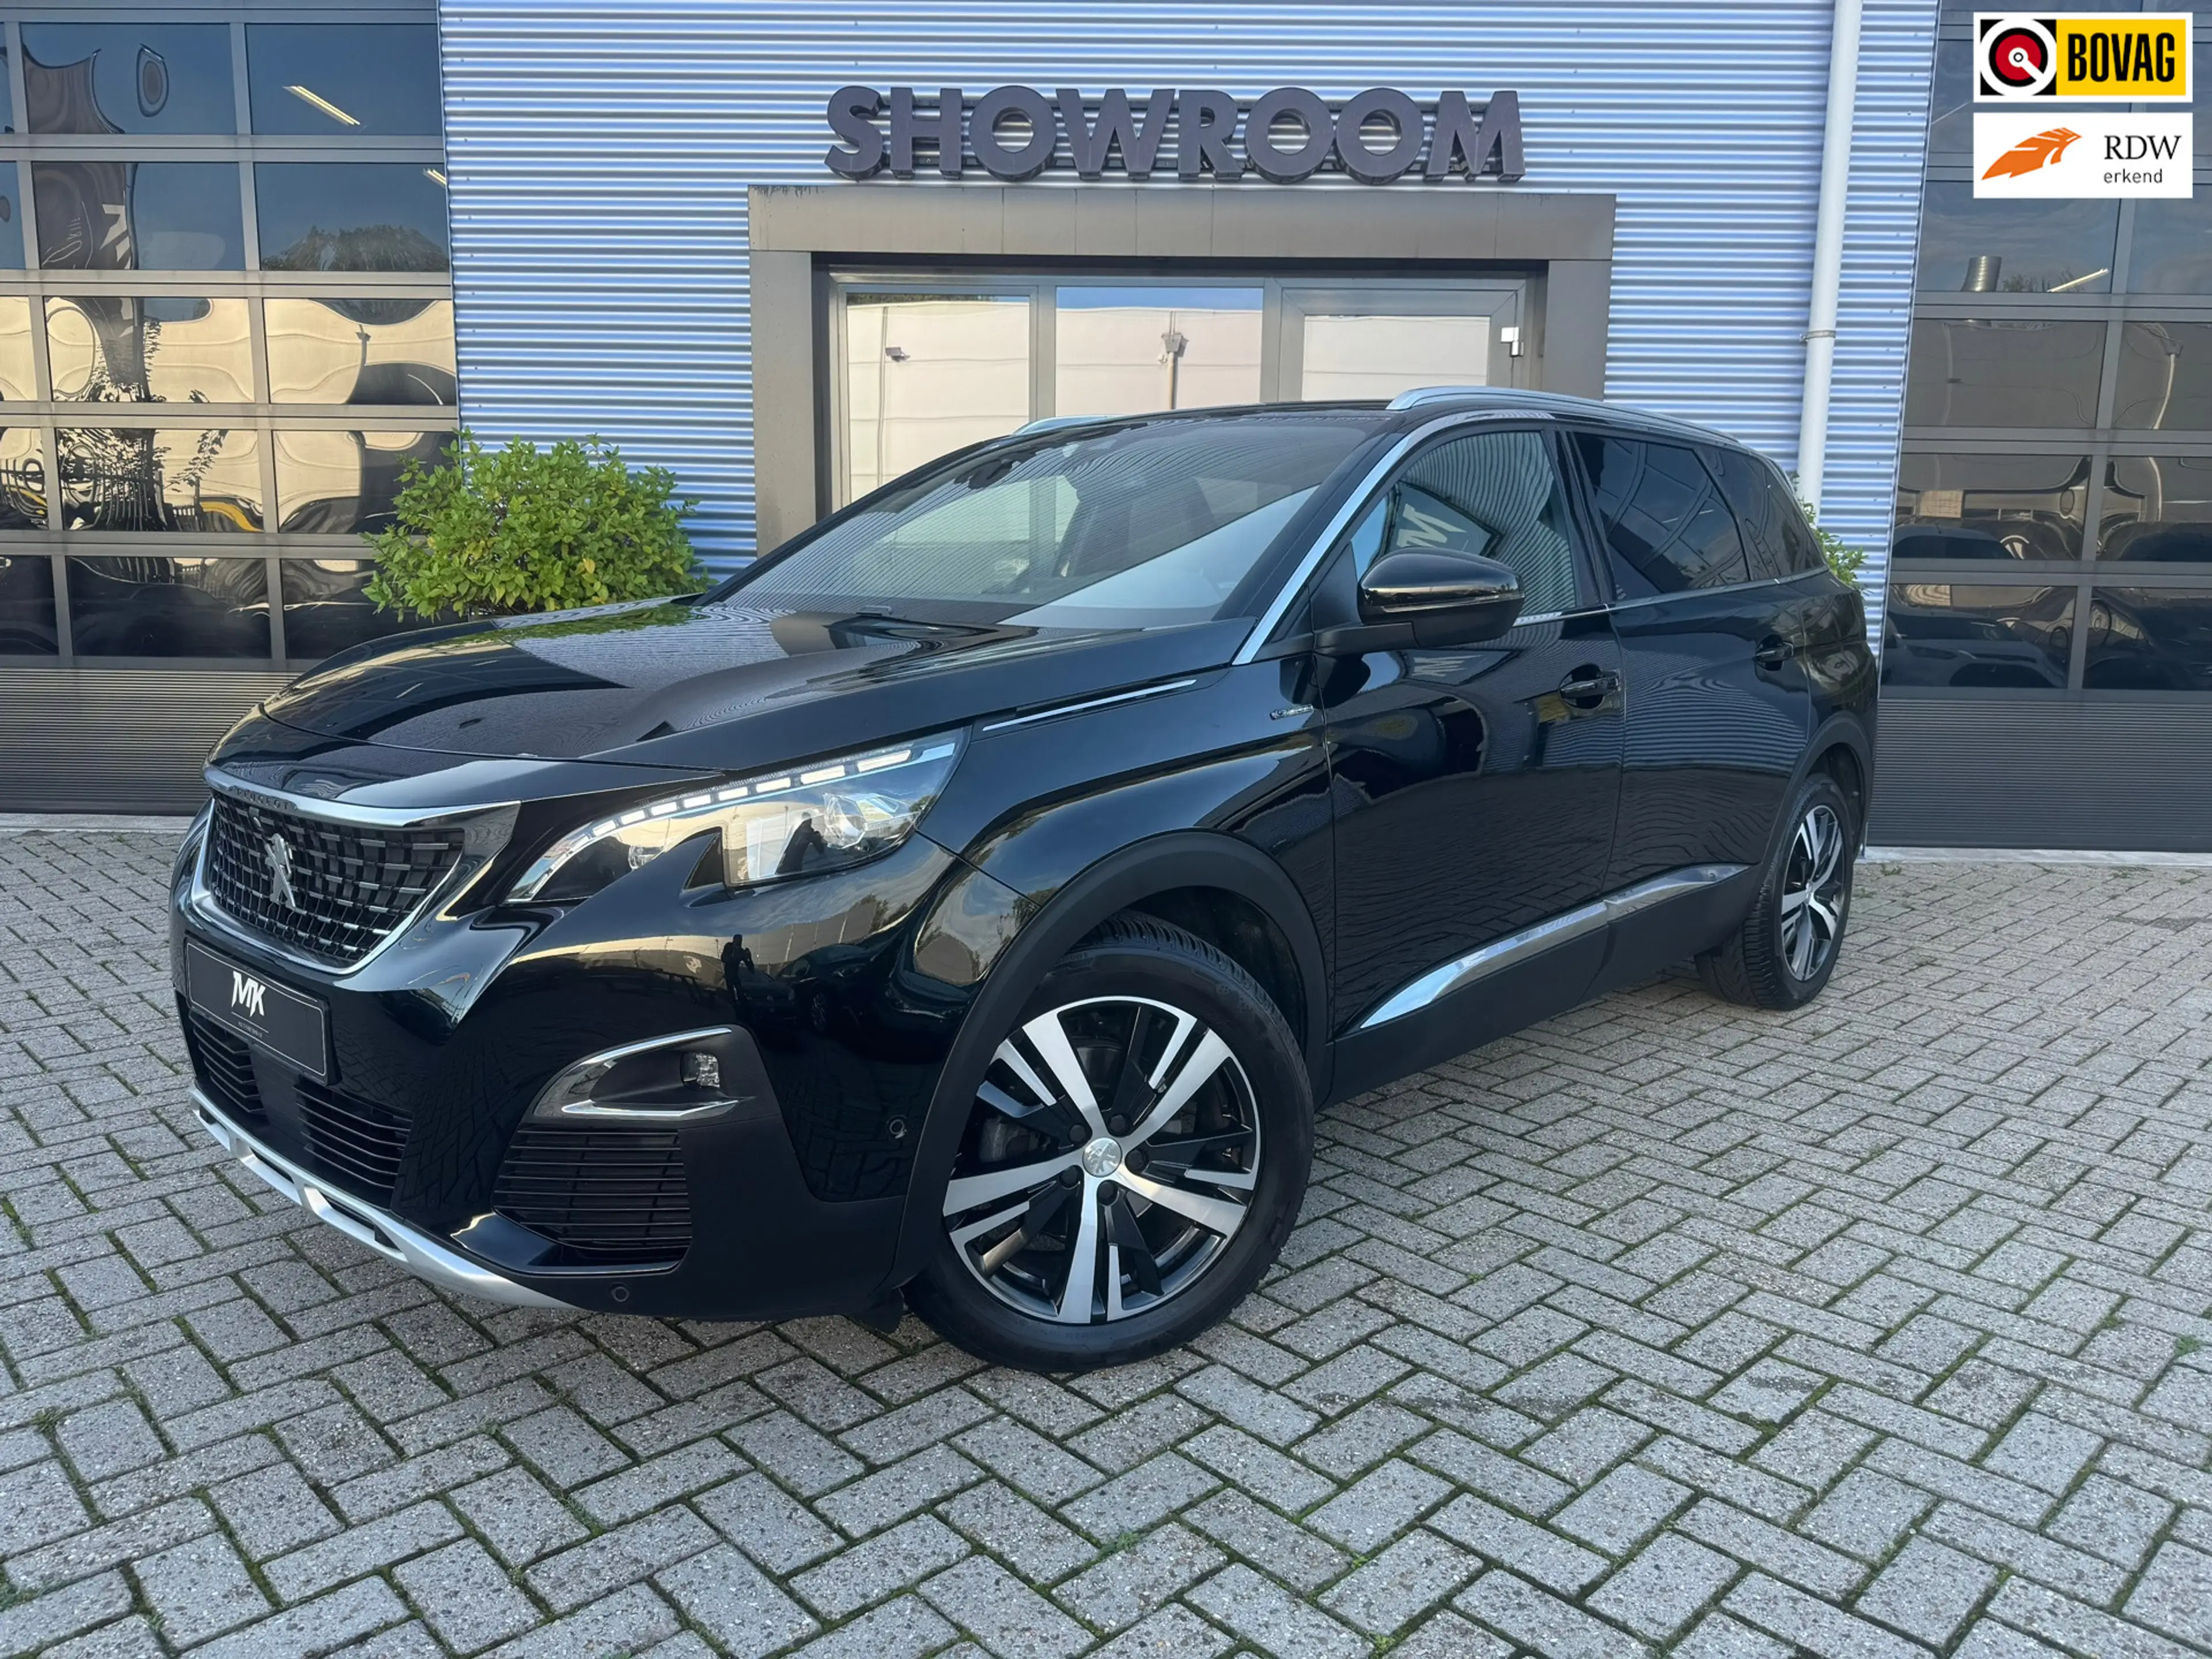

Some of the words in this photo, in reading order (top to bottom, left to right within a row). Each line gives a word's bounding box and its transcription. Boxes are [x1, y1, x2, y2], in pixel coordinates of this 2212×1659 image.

[824, 85, 1526, 183] SHOWROOM
[236, 787, 289, 810] PEUGEOT
[232, 970, 266, 1017] MK
